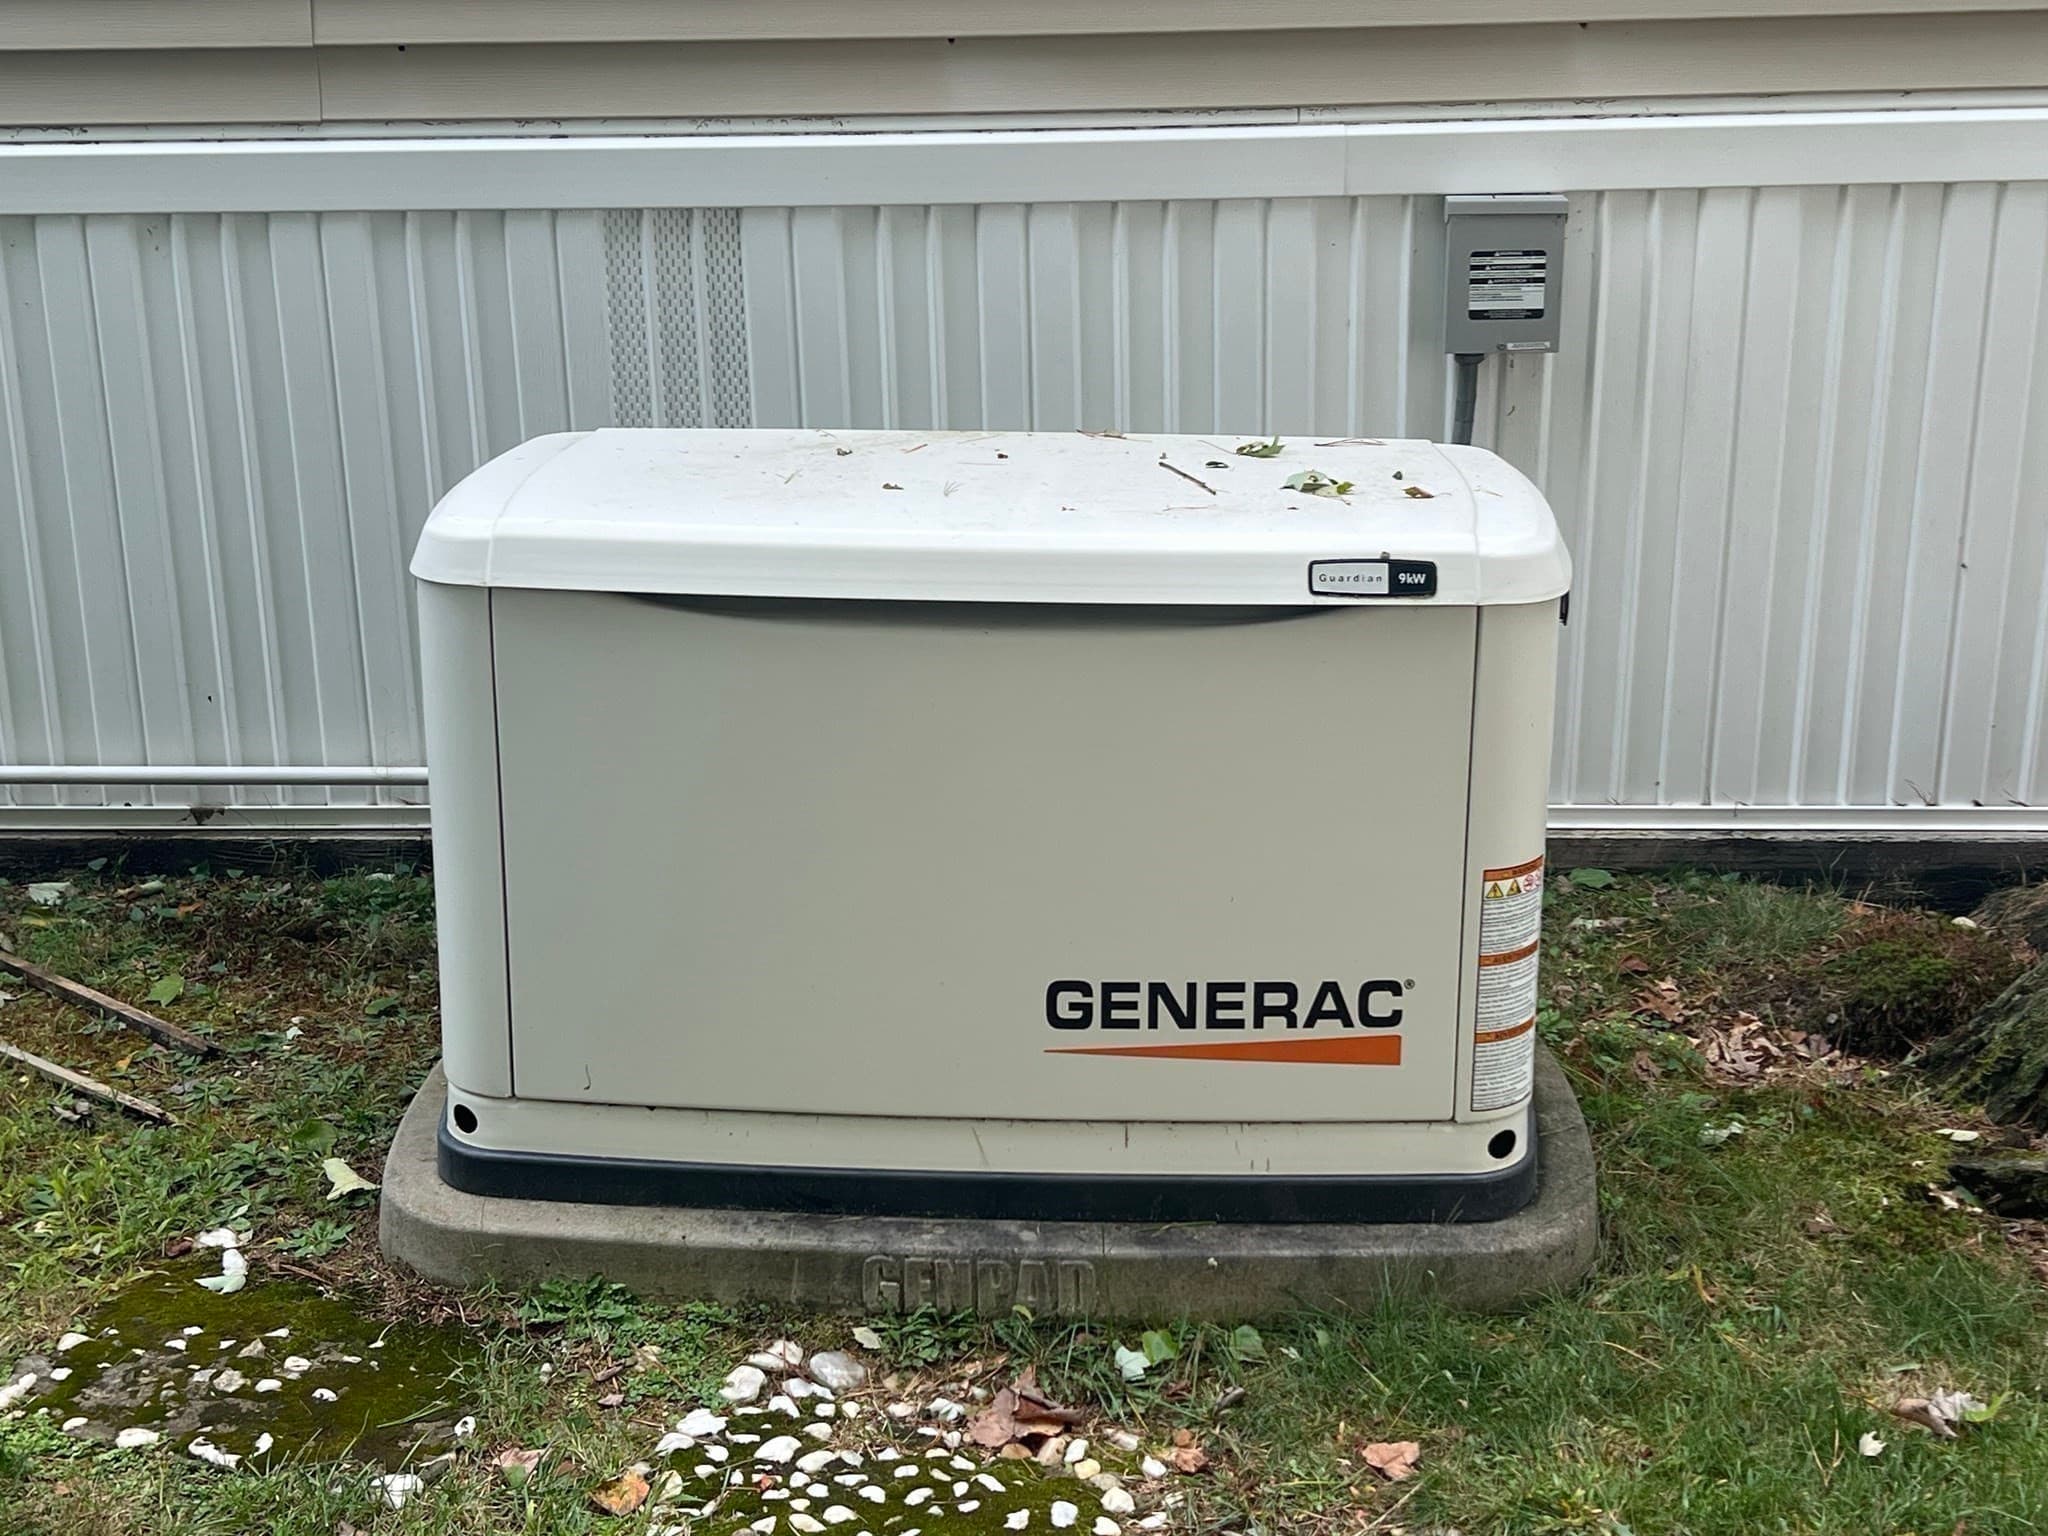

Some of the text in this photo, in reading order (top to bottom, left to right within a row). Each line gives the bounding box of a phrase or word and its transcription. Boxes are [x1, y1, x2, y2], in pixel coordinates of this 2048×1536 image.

[1318, 573, 1427, 585] Guardian 9kW
[1045, 979, 1403, 1030] GENERAC
[862, 1254, 1097, 1315] GENPAD
